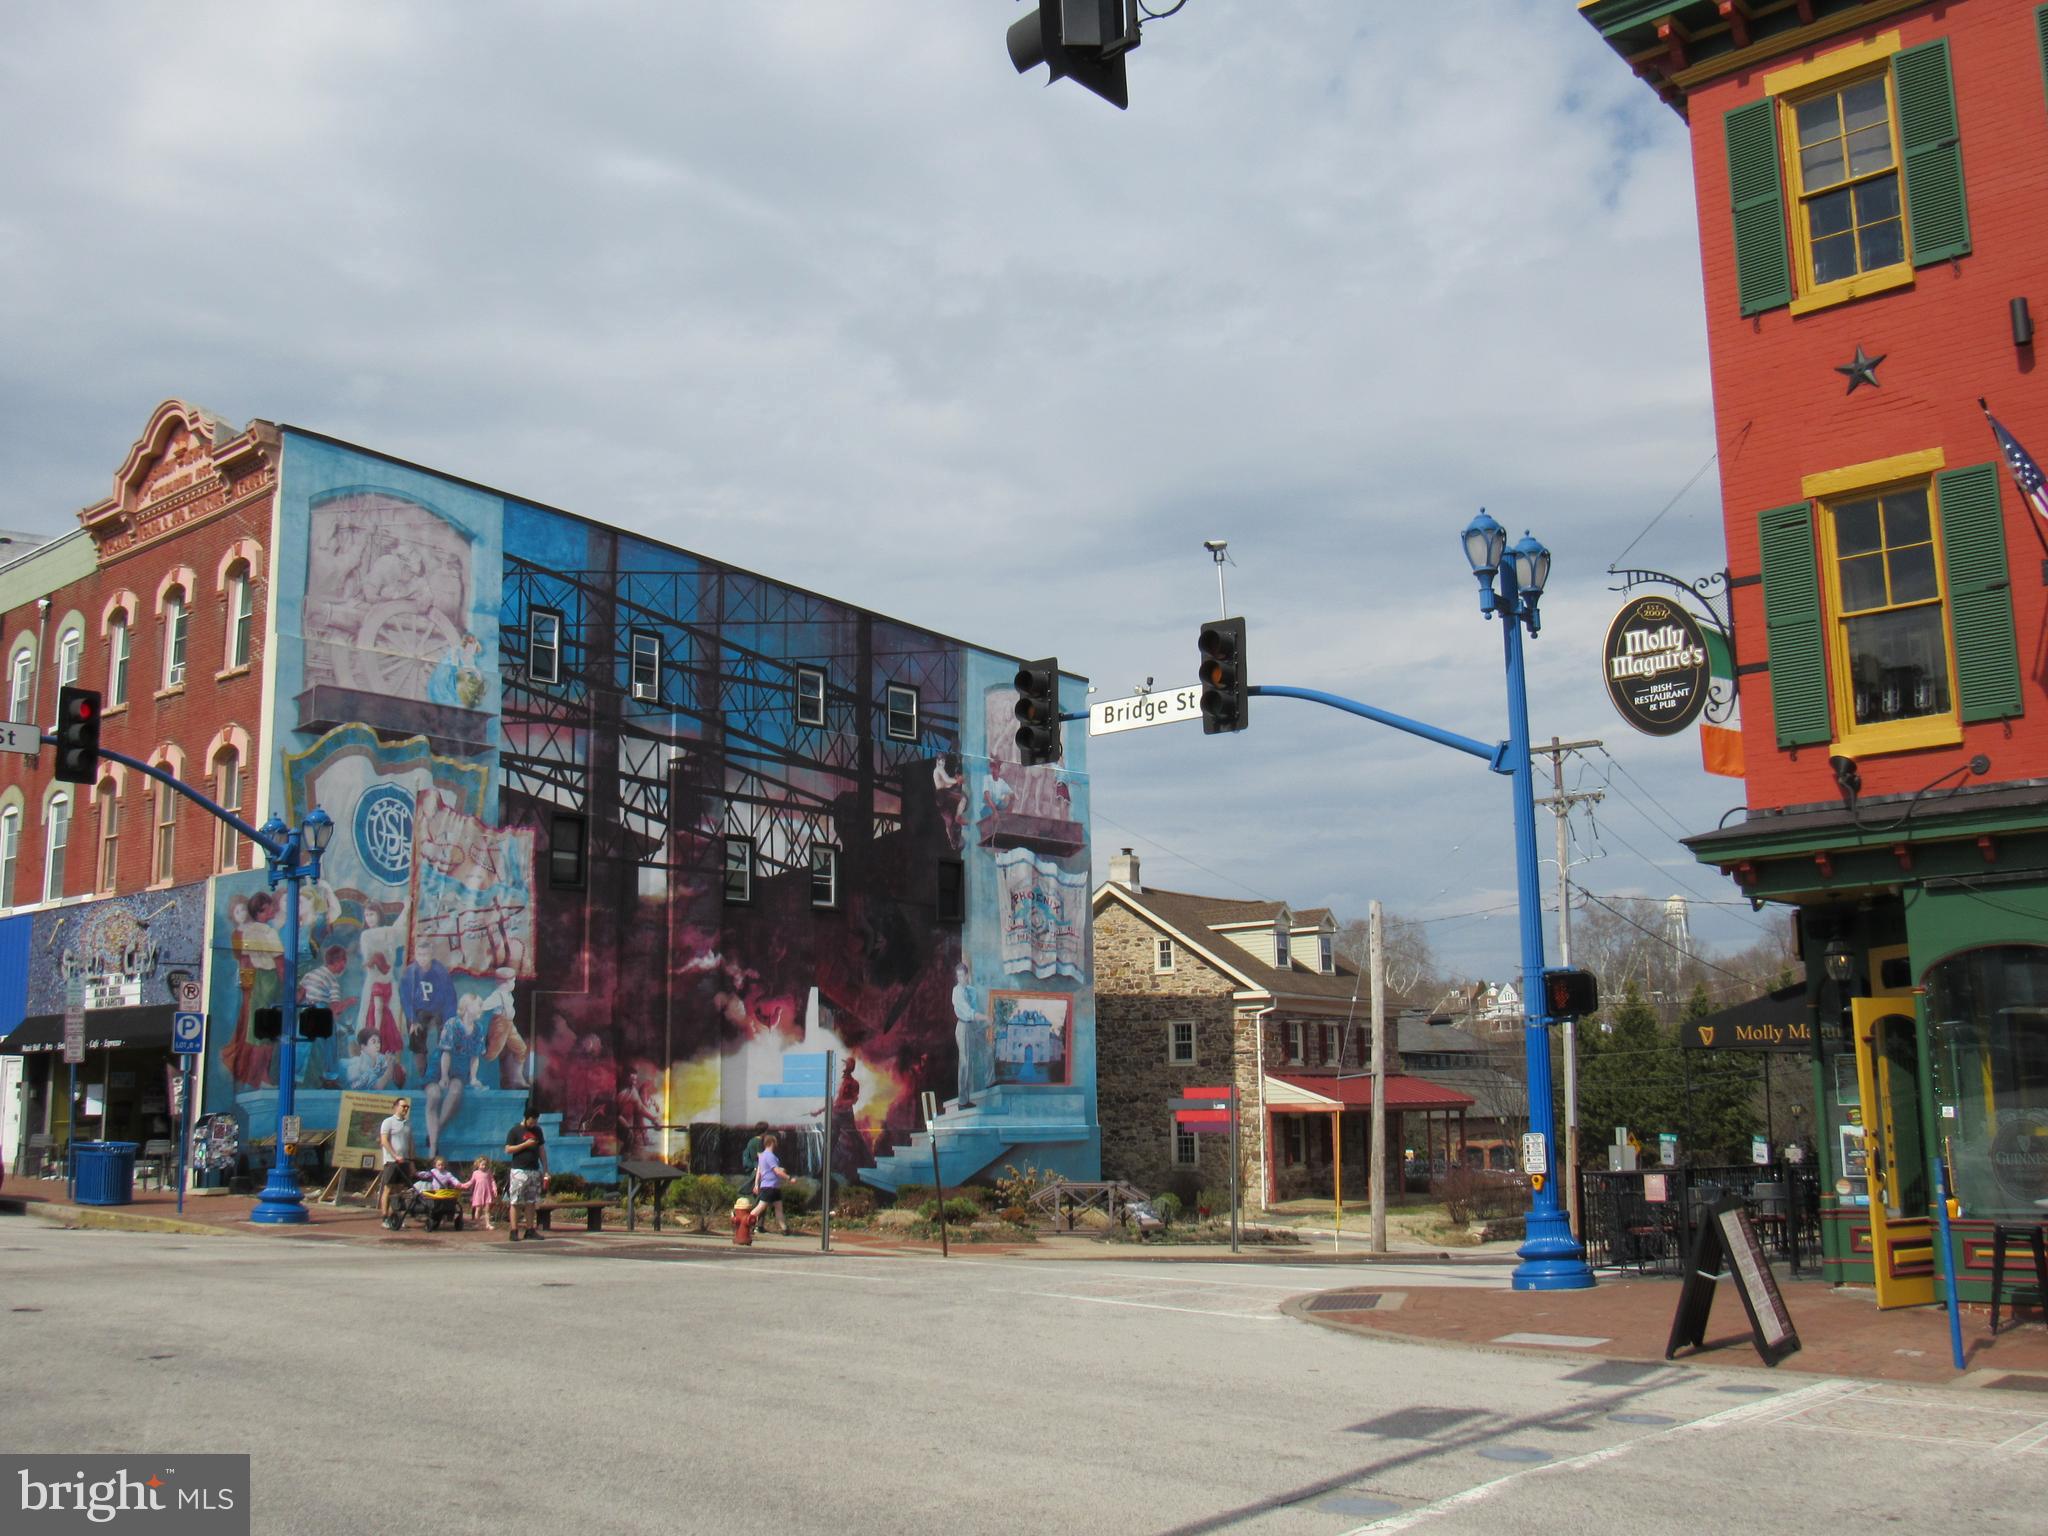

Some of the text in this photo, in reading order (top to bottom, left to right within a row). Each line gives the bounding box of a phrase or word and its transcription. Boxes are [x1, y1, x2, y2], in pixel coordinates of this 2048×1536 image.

[1624, 625, 1685, 655] Molly
[1611, 644, 1704, 679] Maguire's
[1634, 688, 1690, 705] RESTAURANT
[1650, 682, 1672, 693] IRISH
[1104, 692, 1195, 723] Bridge St
[1660, 700, 1676, 710] PUB
[1011, 891, 1060, 914] PHOENIX
[420, 981, 433, 1001] P
[1736, 1024, 1784, 1043] Molly
